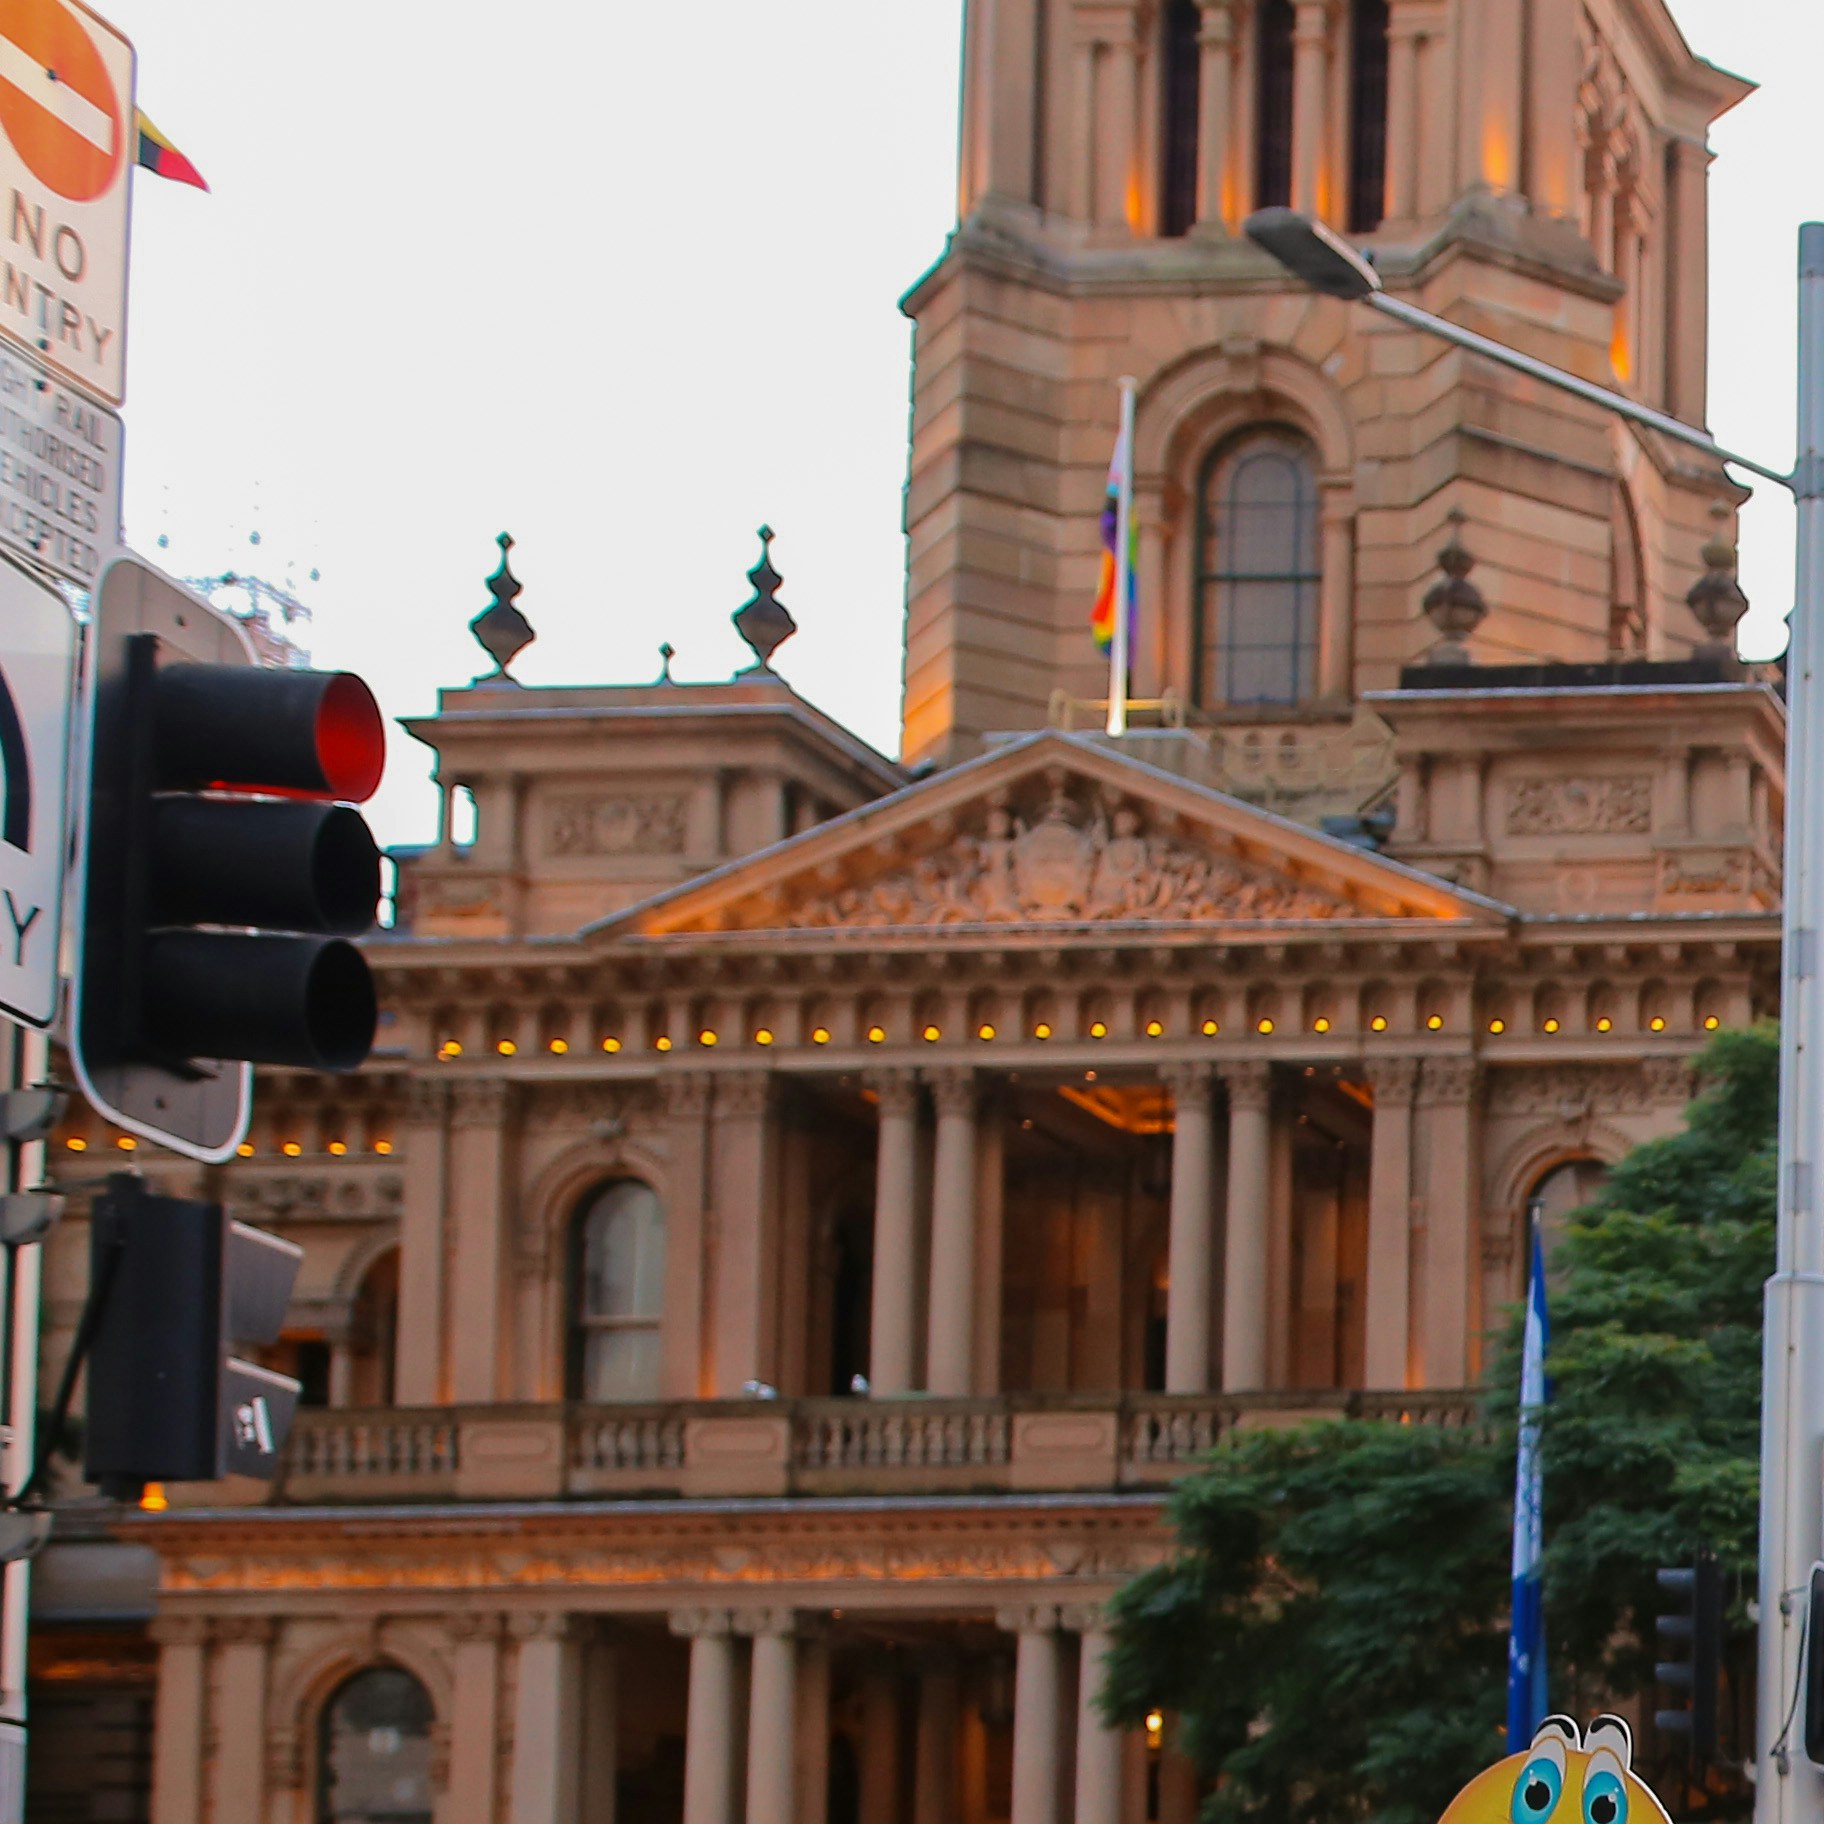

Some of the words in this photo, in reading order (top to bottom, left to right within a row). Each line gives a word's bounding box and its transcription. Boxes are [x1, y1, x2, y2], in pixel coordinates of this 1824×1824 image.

[12, 186, 88, 284] NO
[0, 261, 114, 367] NTRY
[55, 392, 108, 454] RAIL
[0, 450, 98, 535] EHICLES
